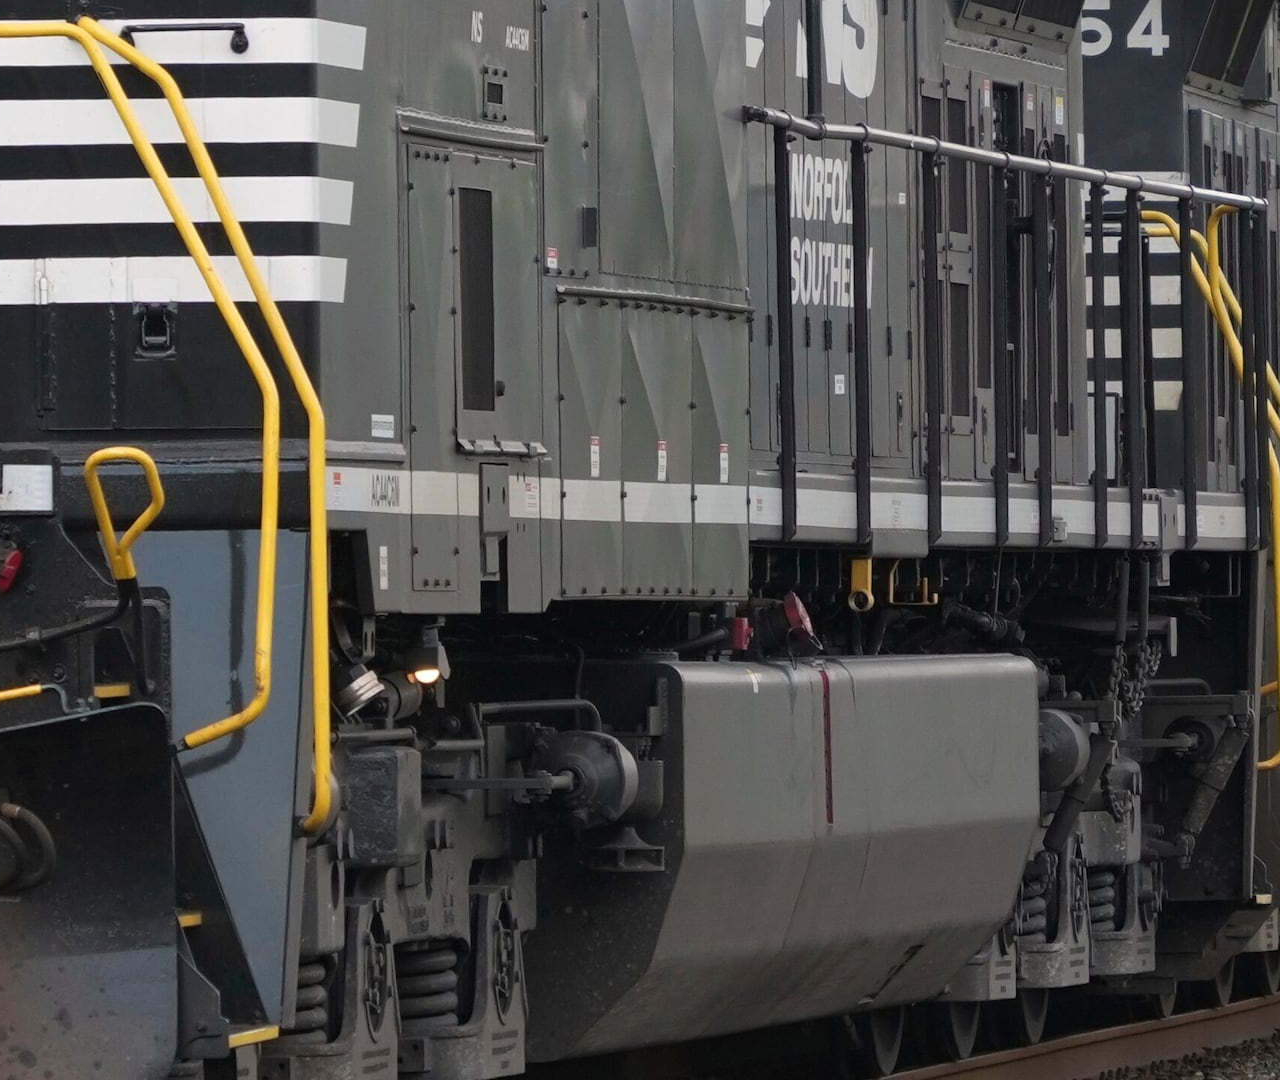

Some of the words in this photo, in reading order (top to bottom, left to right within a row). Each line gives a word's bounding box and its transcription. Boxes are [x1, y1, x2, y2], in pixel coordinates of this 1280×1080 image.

[471, 11, 483, 43] NS
[790, 152, 854, 224] NORFOL
[790, 235, 874, 309] SOUTHEN
